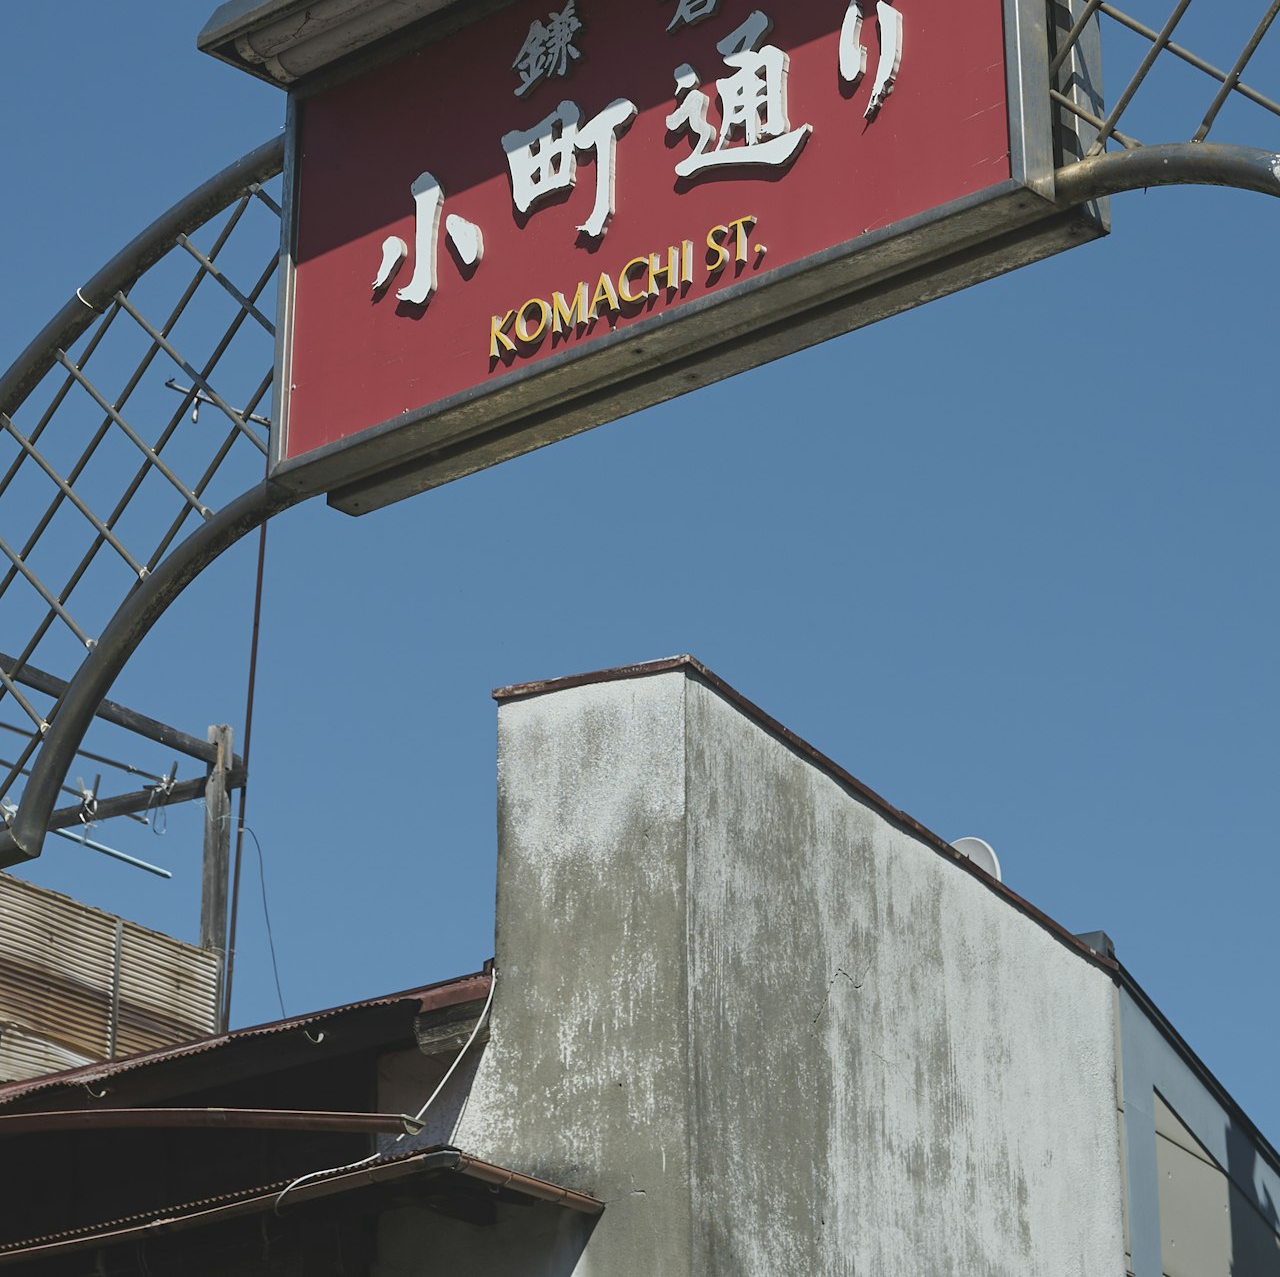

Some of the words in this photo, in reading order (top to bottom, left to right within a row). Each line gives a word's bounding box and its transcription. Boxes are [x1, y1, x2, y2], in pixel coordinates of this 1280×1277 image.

[372, 0, 903, 304] 小町通り
[489, 240, 693, 359] KOMACHI
[706, 216, 767, 272] ST.
